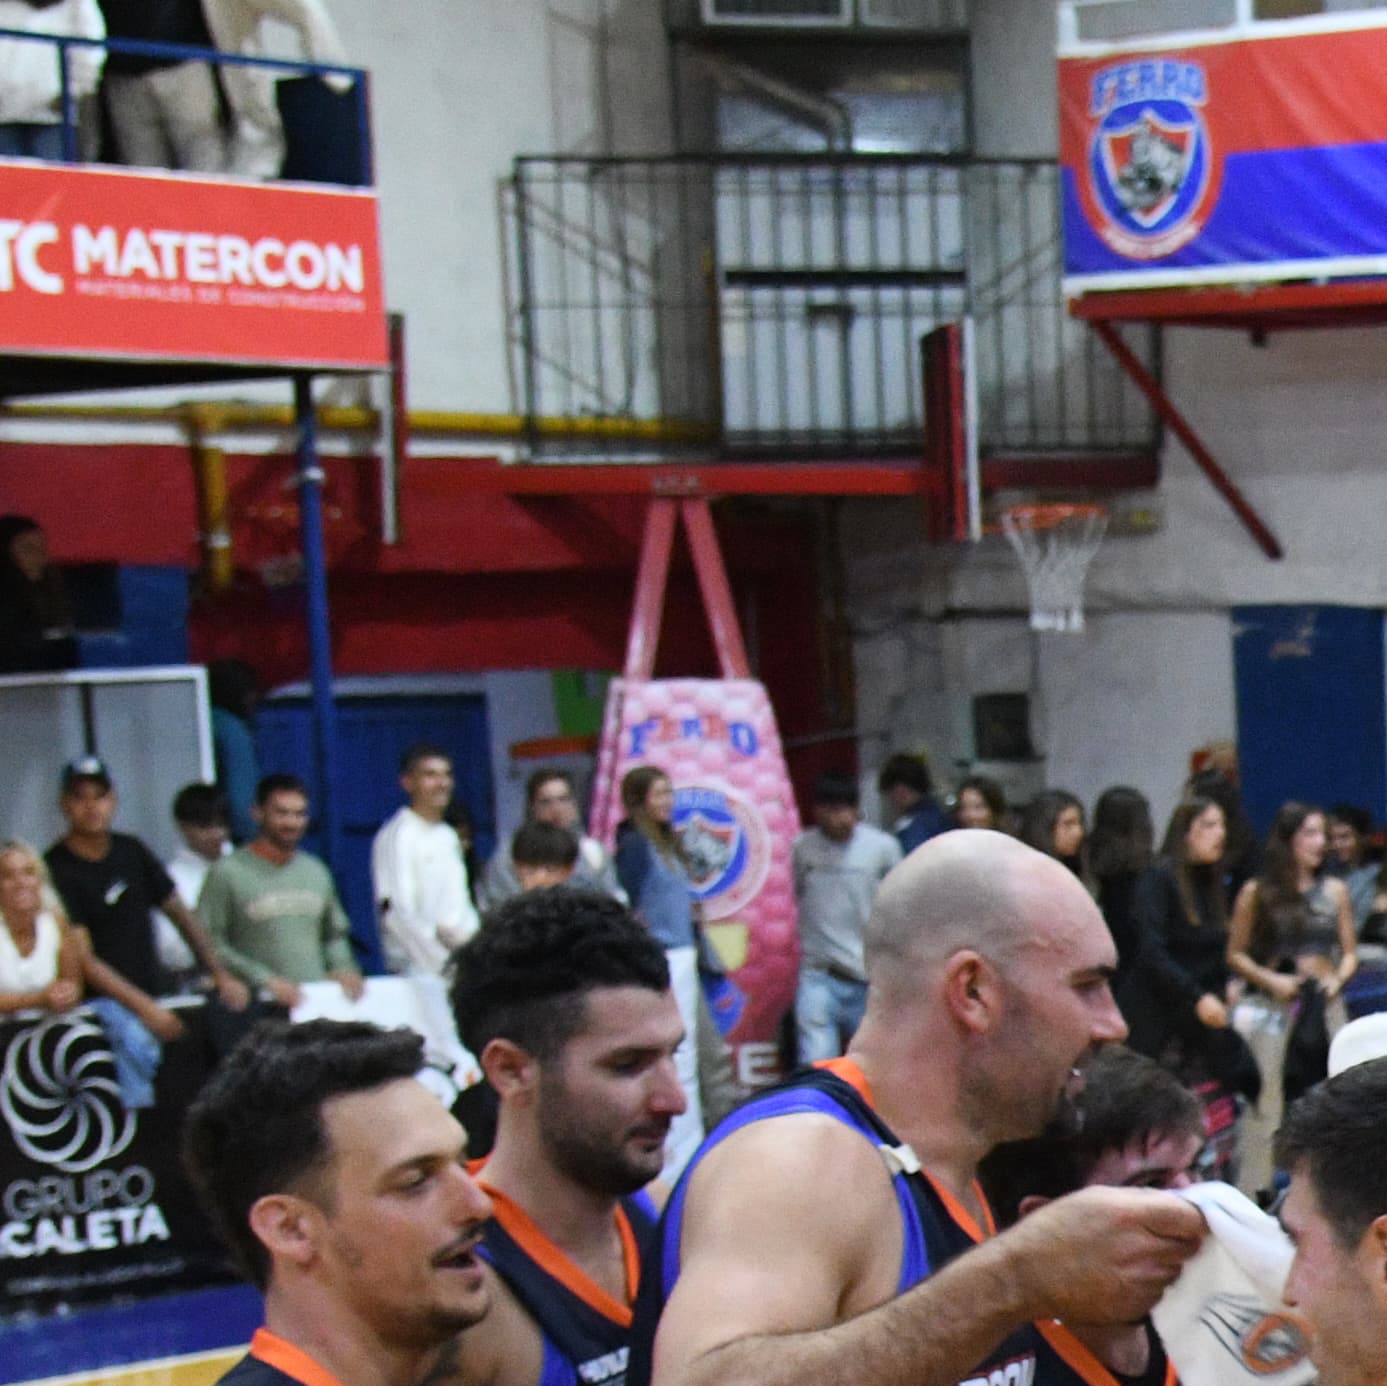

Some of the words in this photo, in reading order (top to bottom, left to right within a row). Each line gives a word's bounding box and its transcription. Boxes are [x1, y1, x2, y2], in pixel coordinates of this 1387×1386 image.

[71, 223, 365, 293] MATERCON
[4, 1164, 155, 1222] GRUPO
[0, 1202, 171, 1259] CALETA
